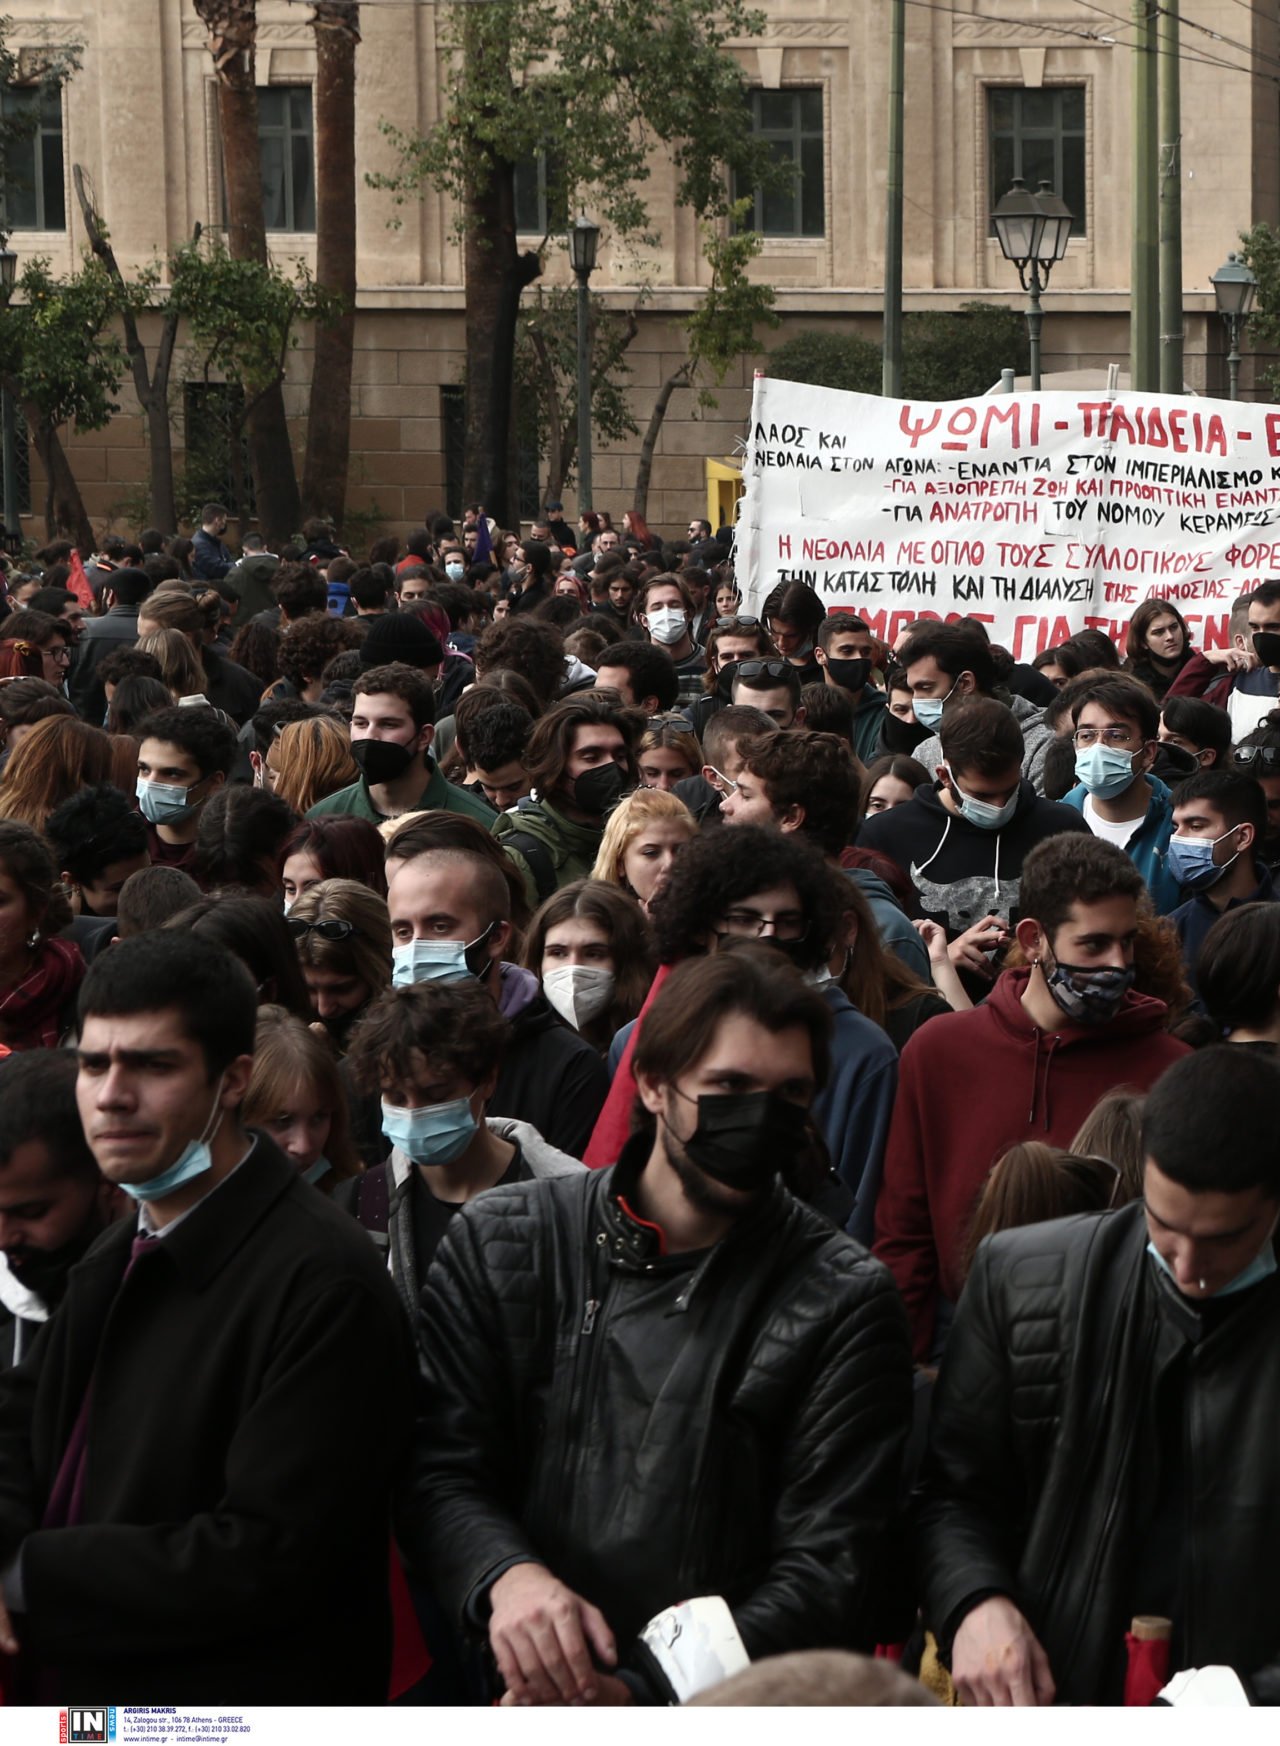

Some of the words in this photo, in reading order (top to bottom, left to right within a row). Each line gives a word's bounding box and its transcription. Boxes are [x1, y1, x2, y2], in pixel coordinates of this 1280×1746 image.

[755, 422, 811, 448] ΛΑΟΣ
[818, 431, 846, 449] ΚΑΙ
[900, 401, 1041, 451] ΨΩΜΙ
[1077, 401, 1227, 457] ΠΑΙΔΕΙΑ
[755, 450, 823, 471] ΝΕΟΛΑΙΑ
[830, 456, 875, 472] ΣΤΟΝ
[1066, 454, 1116, 475] ΣΤΟΝ
[1126, 459, 1263, 490] ΙΜΠΕΡΙΑΛΙΣΜΟ
[924, 477, 1027, 497] ΑΞΙΟΠΡΕΠΗ
[1032, 477, 1068, 498] ΖΩΗ
[1076, 478, 1103, 497] ΚΑΙ
[929, 500, 1038, 525] ΑΝΑΤΡΟΠΗ
[1053, 498, 1088, 521] ΤΟΥ
[1098, 501, 1165, 528] ΝΟΜΟΥ
[779, 534, 792, 561] Η
[802, 538, 885, 563] ΝΕΟΛΑΙΑ
[896, 541, 926, 566] ΜΕ
[931, 540, 985, 566] ΟΠΛΟ
[996, 542, 1056, 569] ΤΟΥΣ
[1065, 542, 1213, 575] ΣΥΛΛΟΓΙΚΟΥΣ
[953, 574, 985, 601] ΚΑΙ
[990, 576, 1016, 600] ΤΗ
[1020, 576, 1094, 602] ΔΙΑΛΥΣΗ
[1103, 580, 1139, 604] ΤΗΣ
[1145, 578, 1231, 603] ΔΗΜΟΣΙΑΣ
